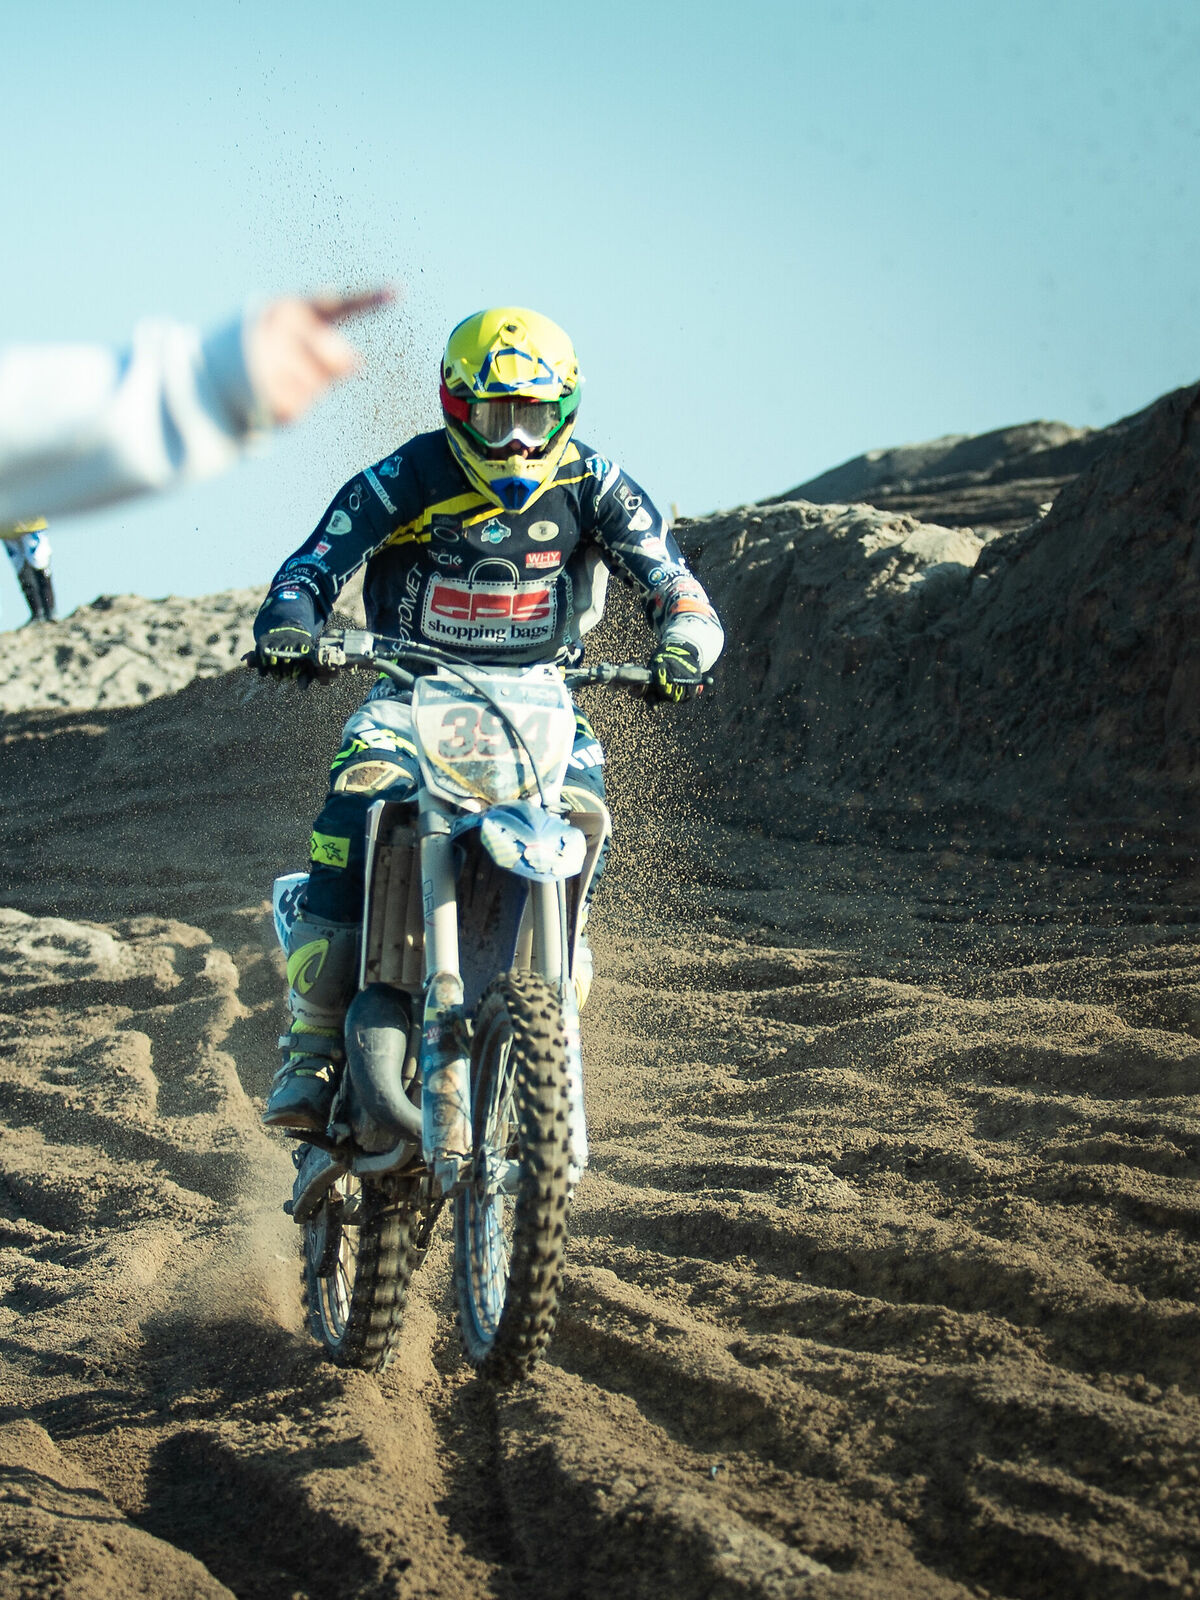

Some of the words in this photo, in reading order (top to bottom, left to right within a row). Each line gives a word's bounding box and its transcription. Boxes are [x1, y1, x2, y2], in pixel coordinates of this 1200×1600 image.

[528, 552, 561, 564] WHY
[430, 585, 550, 622] GPS
[428, 619, 507, 642] shopping
[510, 624, 550, 640] bags
[438, 706, 551, 763] 394
